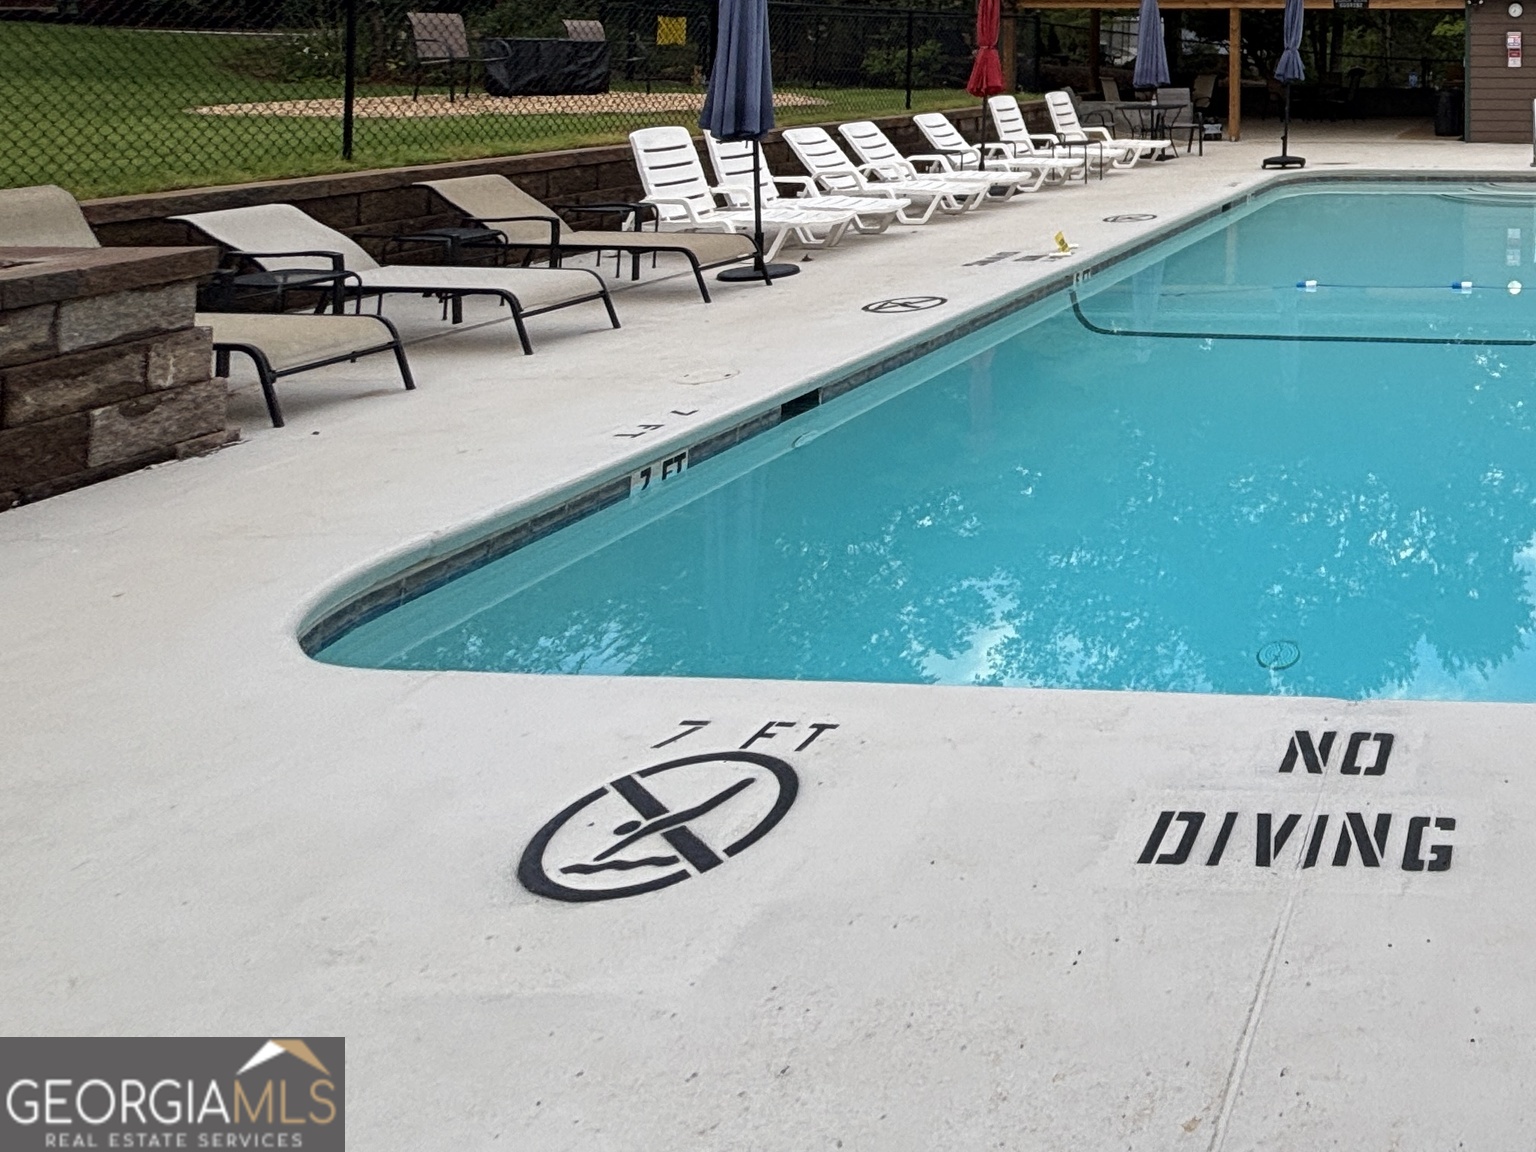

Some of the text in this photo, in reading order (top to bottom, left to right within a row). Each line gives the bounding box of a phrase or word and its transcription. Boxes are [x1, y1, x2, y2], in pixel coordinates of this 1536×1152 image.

[640, 452, 687, 491] 7 FT
[650, 720, 840, 751] 7 FT
[1278, 730, 1394, 776] NO
[1137, 811, 1456, 871] DIVING
